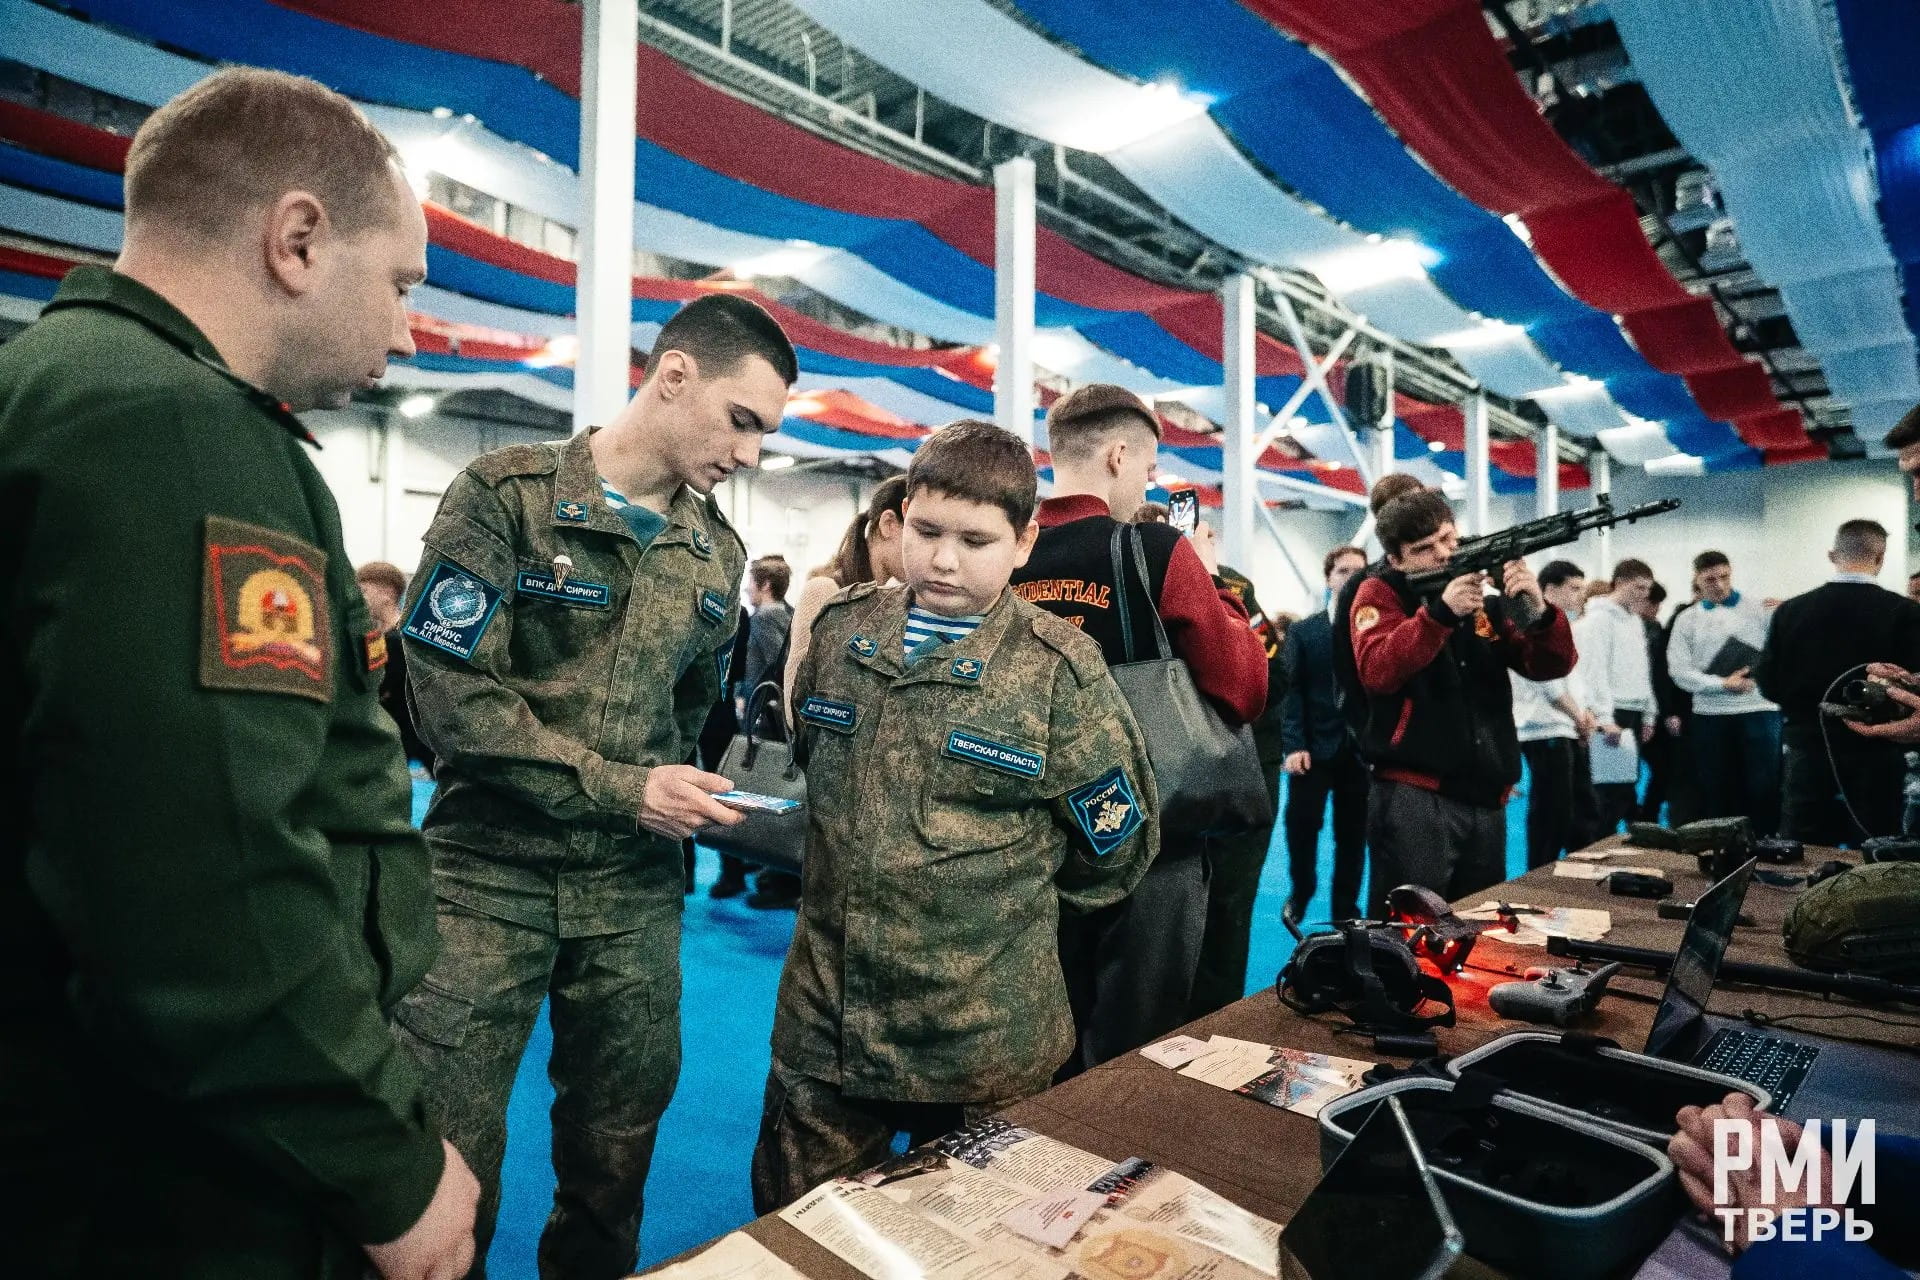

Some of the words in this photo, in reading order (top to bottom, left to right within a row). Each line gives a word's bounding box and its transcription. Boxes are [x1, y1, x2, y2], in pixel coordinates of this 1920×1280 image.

[526, 578, 545, 589] ВПК
[423, 620, 462, 643] СИРИУС
[953, 738, 998, 758] ТВЕРСКАЯ
[1000, 751, 1038, 769] ОБЛАСТЬ
[1084, 783, 1118, 809] РОССИЯ
